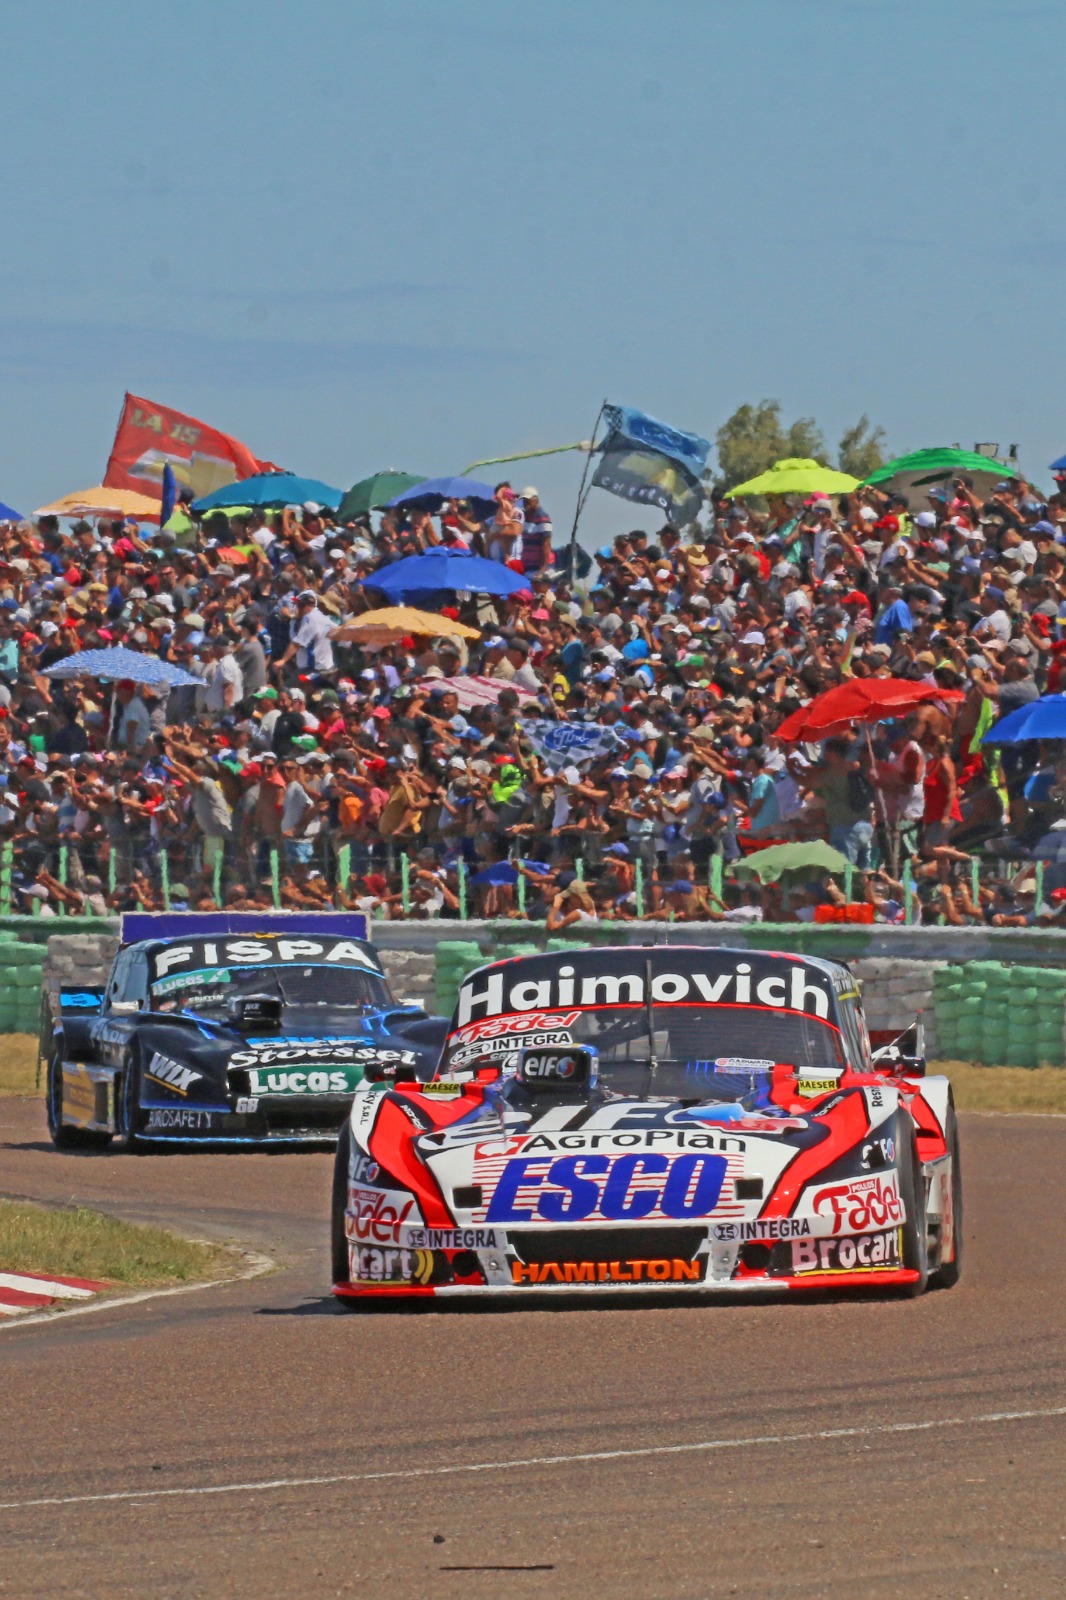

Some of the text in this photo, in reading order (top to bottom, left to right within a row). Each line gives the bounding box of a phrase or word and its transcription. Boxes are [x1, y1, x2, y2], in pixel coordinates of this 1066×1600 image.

[155, 940, 380, 977] FISPA
[157, 974, 204, 994] Lucas
[458, 963, 828, 1027] Haimovich
[459, 1012, 580, 1044] Fadel
[493, 1032, 570, 1051] INTEGRA
[227, 1047, 415, 1070] Stoessel
[150, 1052, 203, 1090] WIX
[250, 1071, 348, 1094] Lucas
[424, 1083, 459, 1092] KAESER
[800, 1079, 836, 1090] KAESER
[484, 1153, 728, 1222] ESCO
[852, 1180, 875, 1193] POLLOS
[813, 1174, 902, 1234] Fadel
[429, 1229, 497, 1248] INTEGRA
[740, 1220, 810, 1240] INTEGRA
[792, 1228, 898, 1272] Brocart
[512, 1259, 700, 1283] HAMILTON
